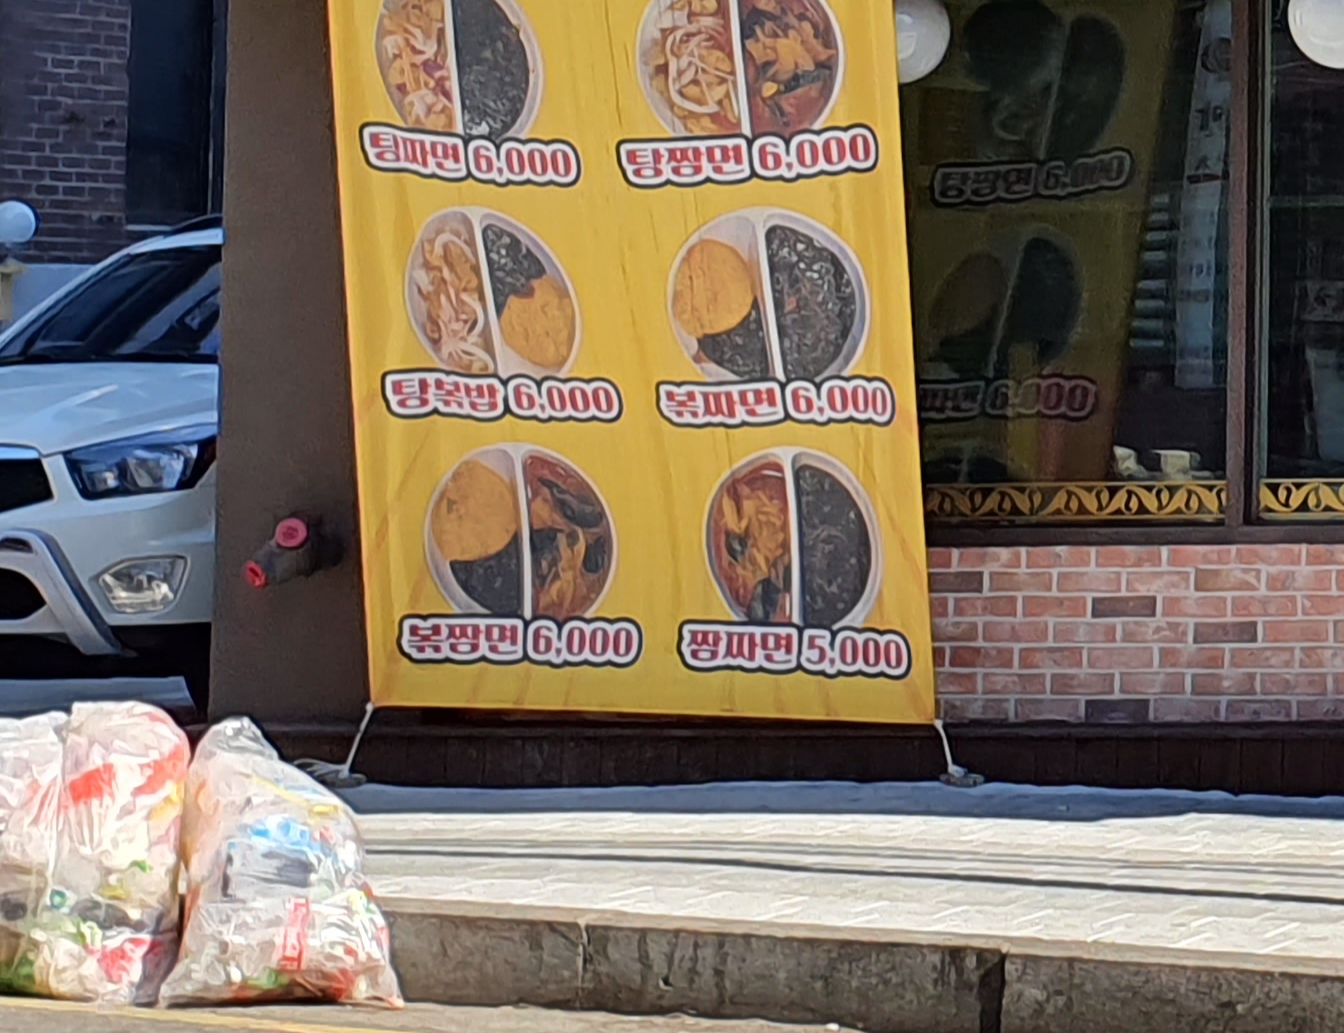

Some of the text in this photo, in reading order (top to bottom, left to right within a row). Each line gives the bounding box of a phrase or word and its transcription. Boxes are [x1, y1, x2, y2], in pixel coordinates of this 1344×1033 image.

[471, 143, 574, 180] 6,000
[756, 131, 873, 174] 6,000
[511, 380, 615, 415] 6,000
[789, 383, 889, 417] 6,000
[530, 623, 634, 659] 6,000
[804, 633, 905, 669] 5,000
